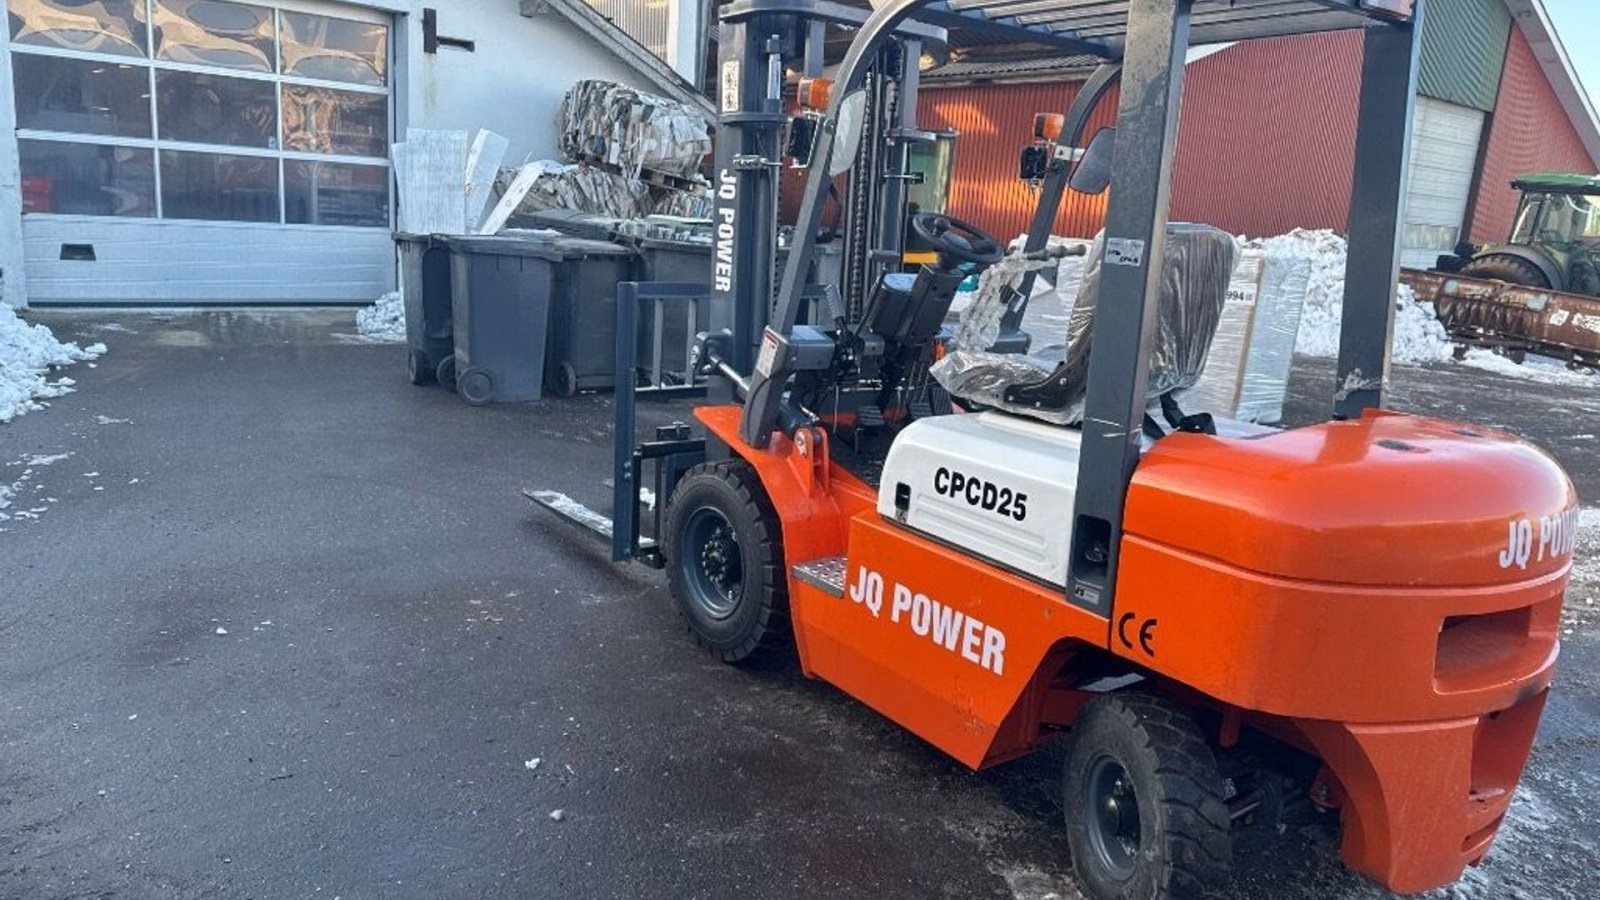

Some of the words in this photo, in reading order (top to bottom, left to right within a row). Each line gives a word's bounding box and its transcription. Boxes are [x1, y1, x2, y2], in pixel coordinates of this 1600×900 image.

[719, 168, 737, 200] JQ
[715, 207, 735, 292] POWER
[934, 467, 1028, 522] CPCD25
[1499, 519, 1532, 570] JQ
[849, 565, 884, 618] JQ
[890, 582, 1006, 676] POWER
[1118, 612, 1157, 658] CE
